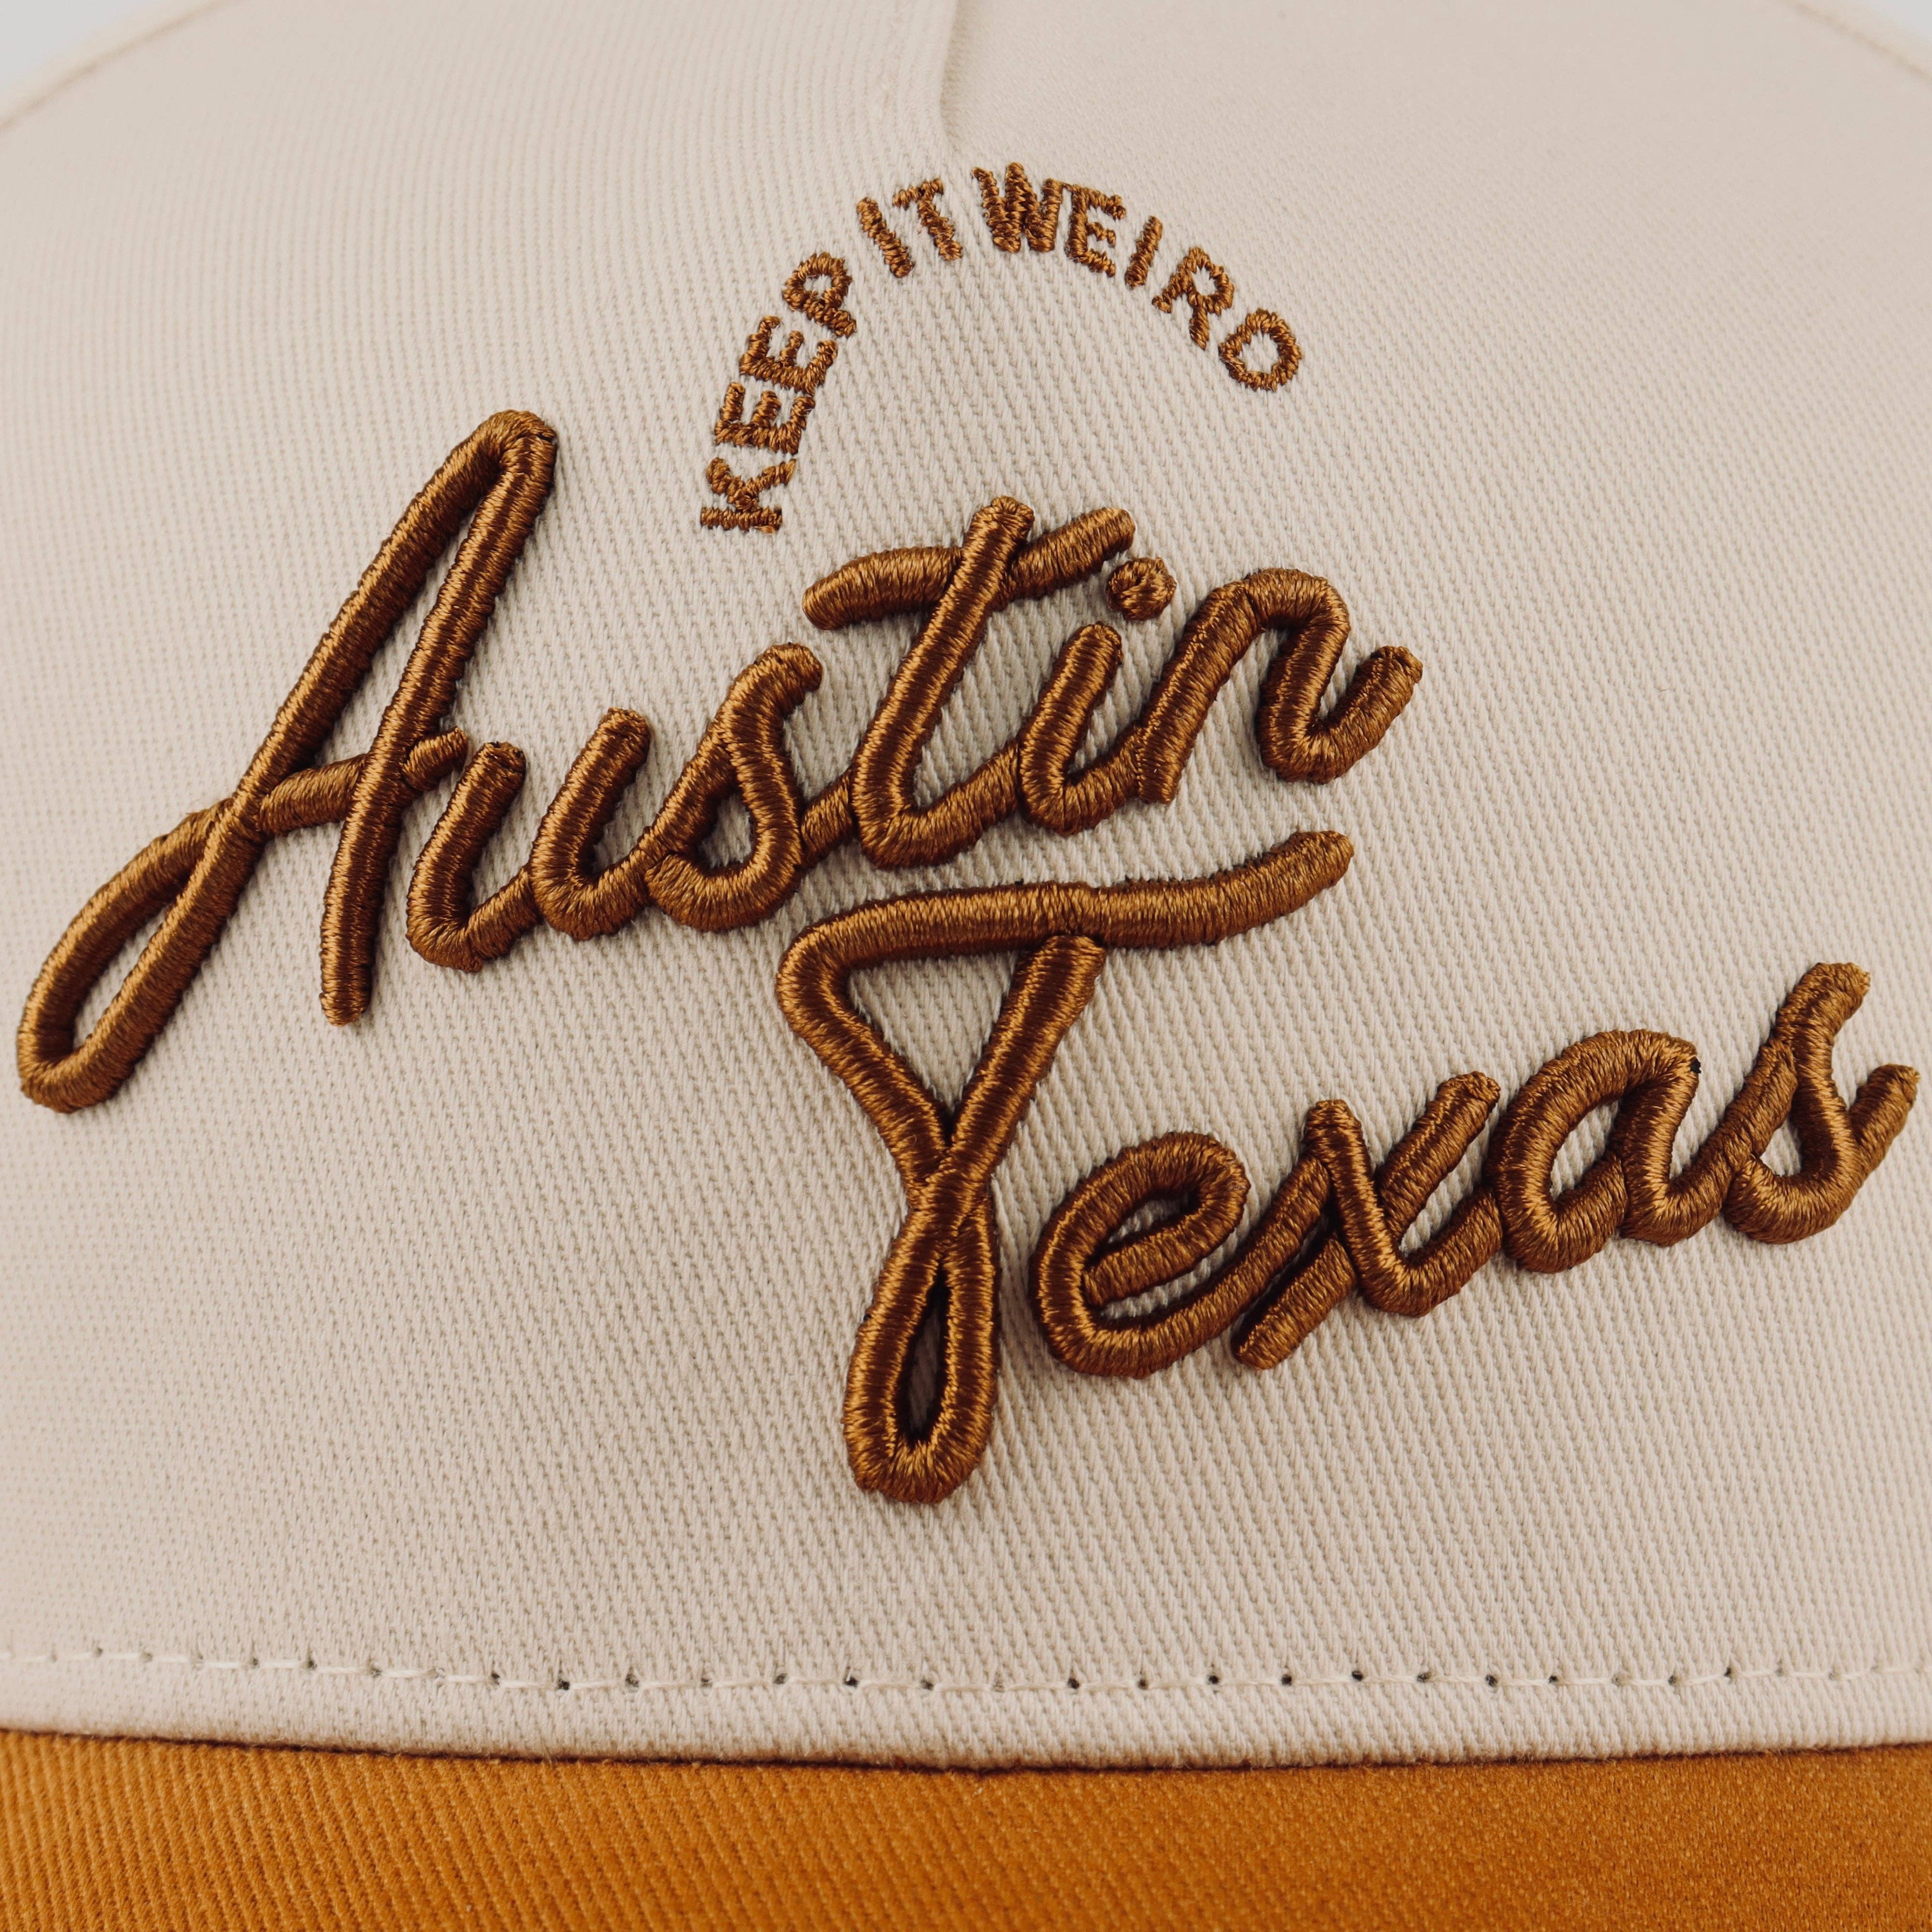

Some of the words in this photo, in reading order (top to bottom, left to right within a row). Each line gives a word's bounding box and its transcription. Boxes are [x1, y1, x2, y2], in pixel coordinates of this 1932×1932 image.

[700, 252, 857, 534] KEEP
[856, 178, 963, 278] IT
[972, 162, 1303, 392] WEIRD
[17, 410, 1423, 1114] Austin
[776, 829, 1920, 1504] Texas
